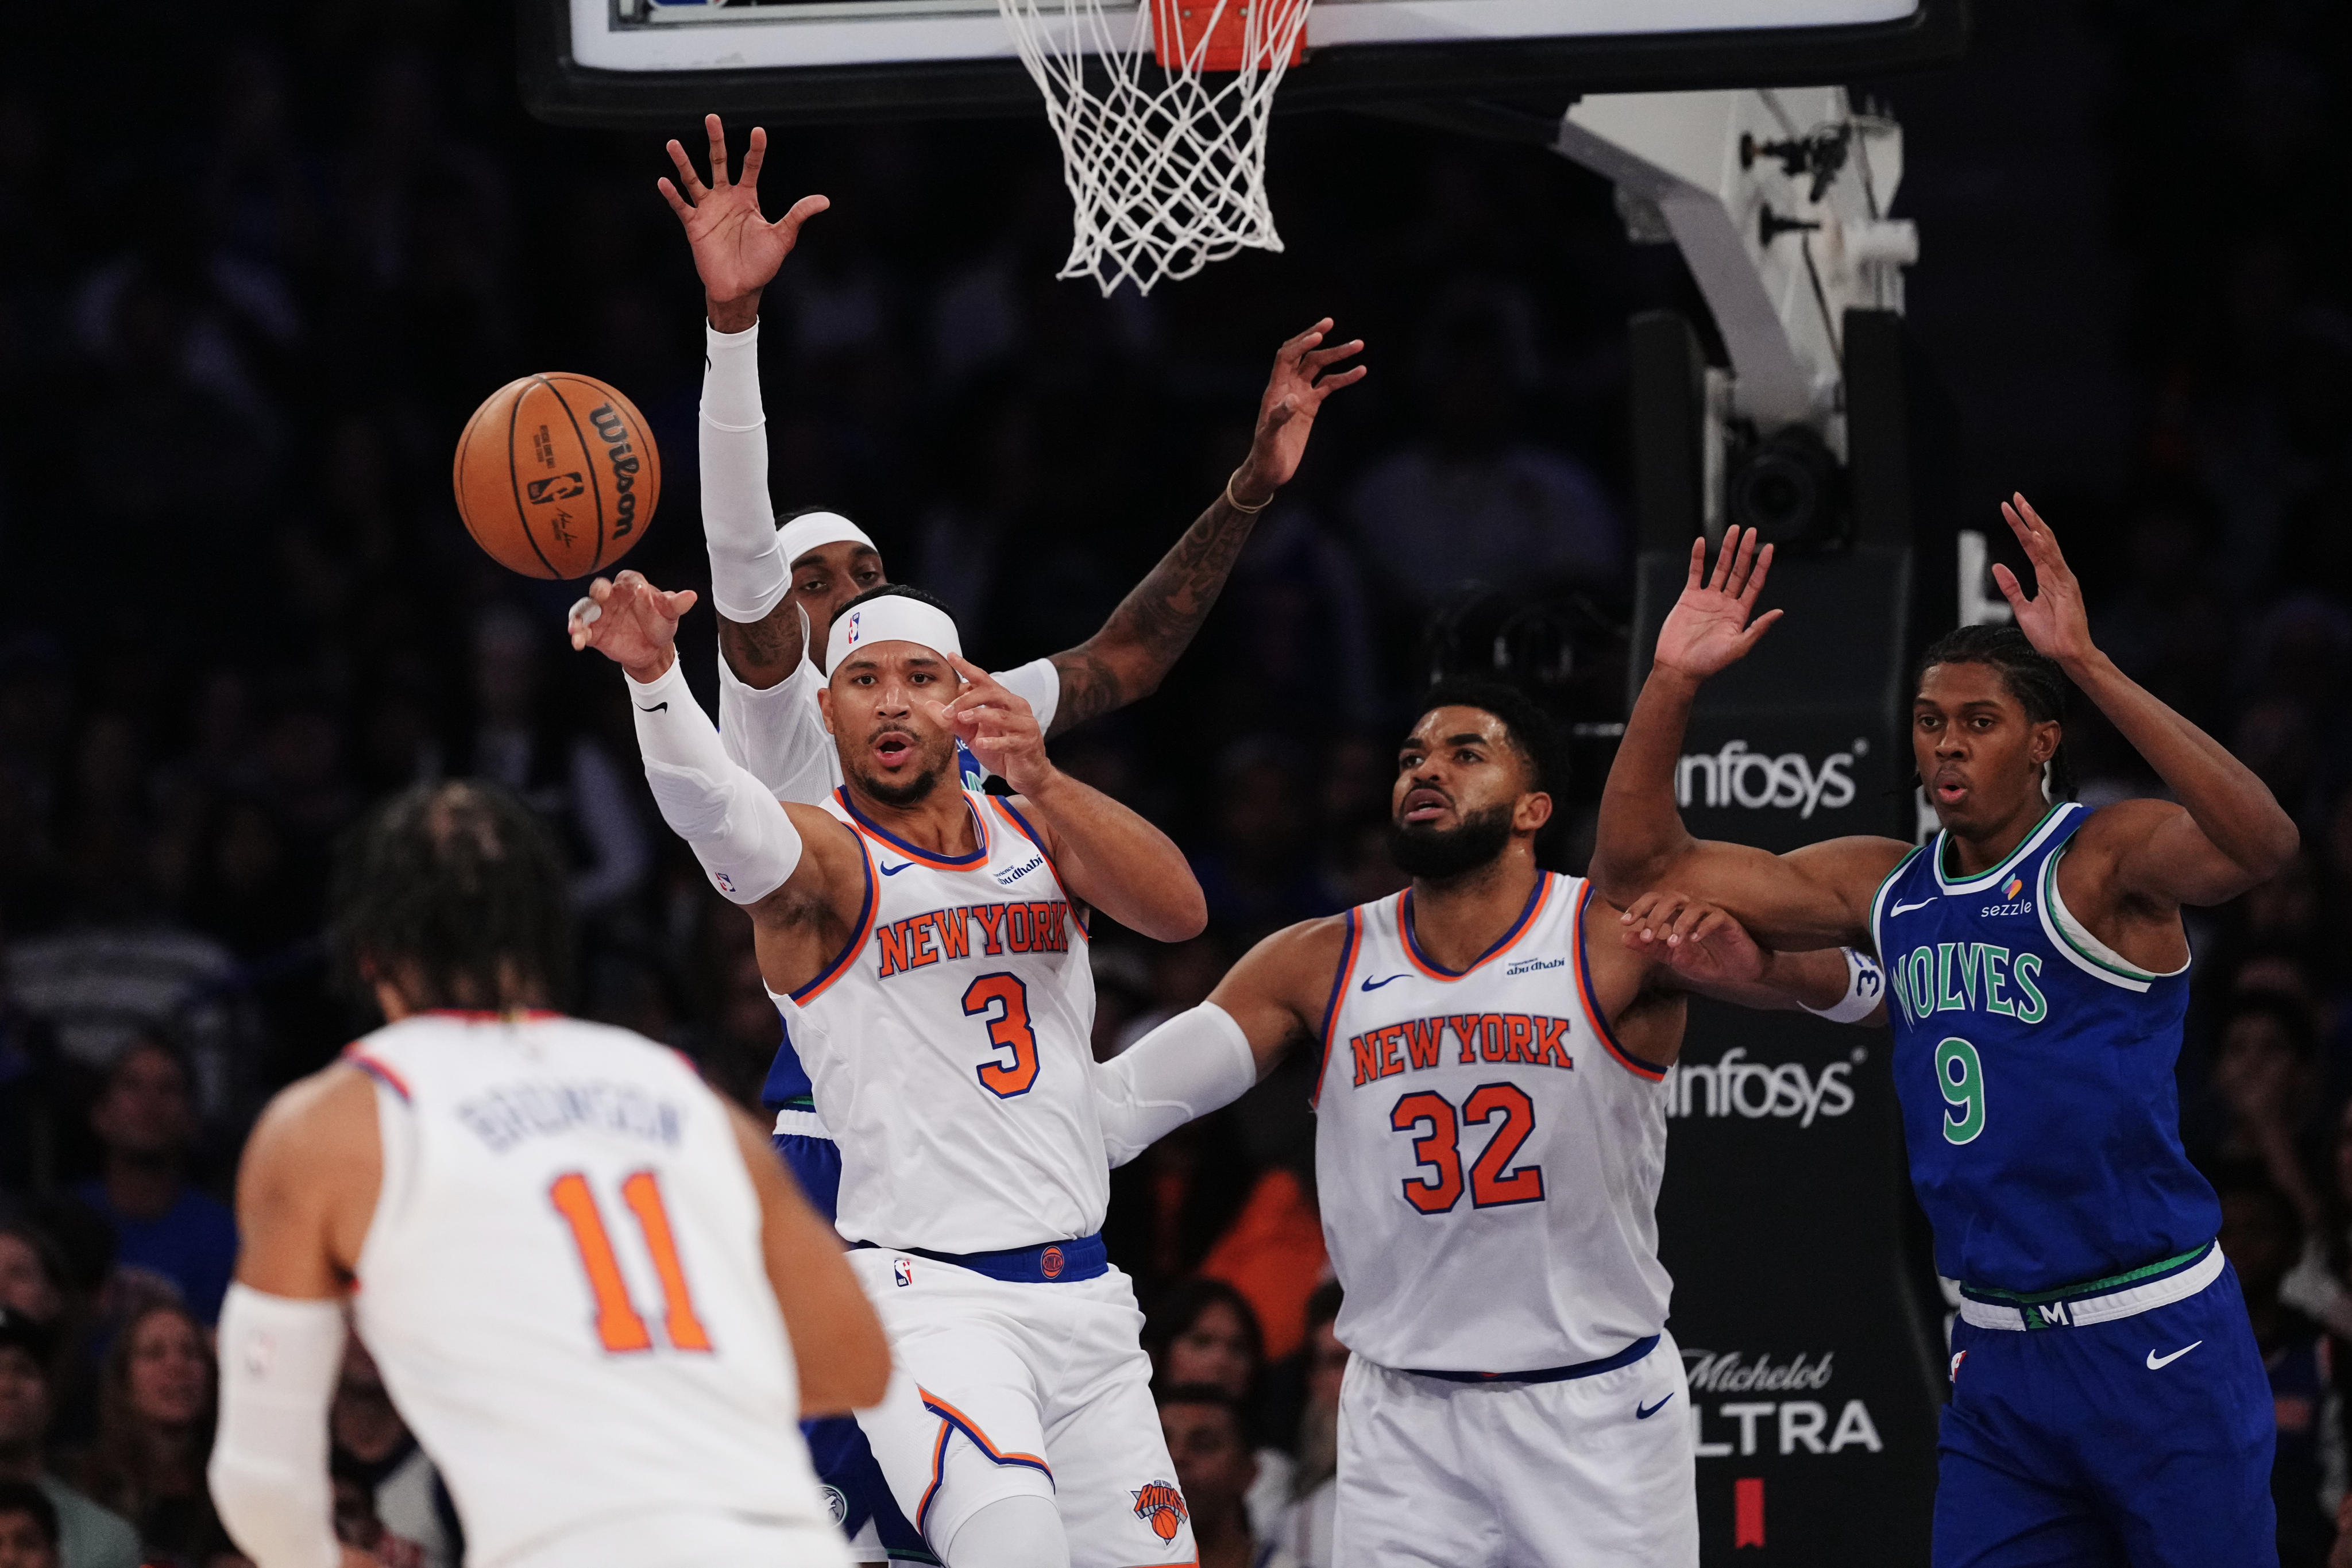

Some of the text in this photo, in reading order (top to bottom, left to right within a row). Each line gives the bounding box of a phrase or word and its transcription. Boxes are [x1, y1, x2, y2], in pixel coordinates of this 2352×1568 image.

[589, 402, 639, 540] Wilson
[1675, 740, 1856, 818] nfosys
[1012, 854, 1043, 879] dhabi
[875, 901, 1069, 981] NEW YORK
[1981, 899, 2032, 917] sezzle
[1507, 967, 1529, 975] abu
[1531, 957, 1565, 971] dhabi
[1889, 942, 2048, 1034] WOLVES
[961, 972, 1040, 1099] 3
[1349, 1013, 1574, 1090] NEW YORK
[1935, 1037, 1986, 1145] 9
[1389, 1081, 1546, 1216] 32
[547, 1168, 715, 1354] 11
[1679, 1349, 1835, 1392] Michelob
[1691, 1399, 1883, 1457] LTRA
[1134, 1484, 1188, 1517] KNICKS
